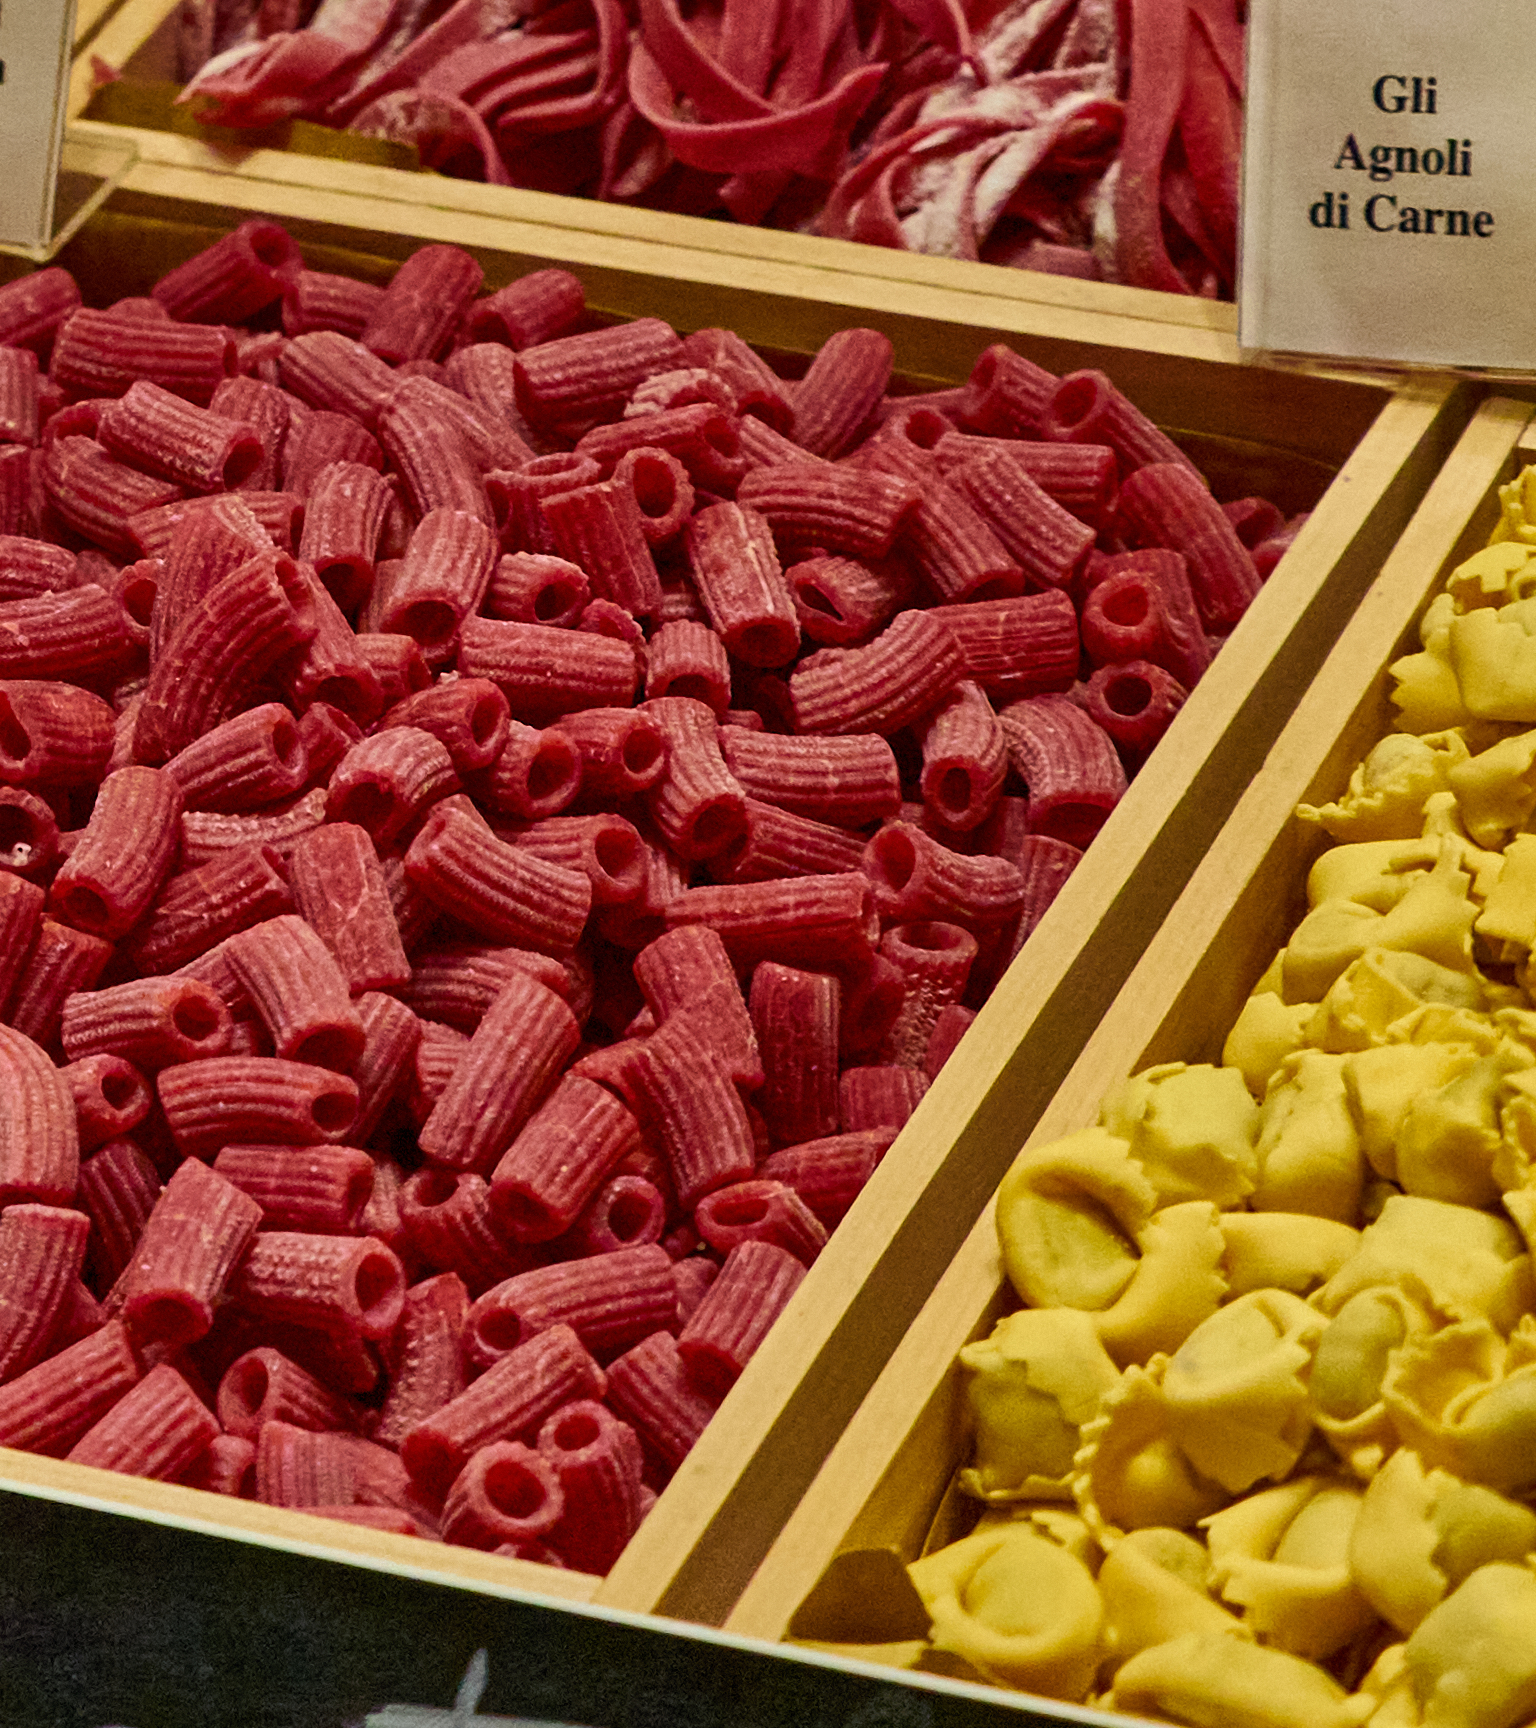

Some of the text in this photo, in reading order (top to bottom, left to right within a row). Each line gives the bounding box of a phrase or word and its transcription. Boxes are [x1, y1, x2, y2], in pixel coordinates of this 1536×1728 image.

[1372, 74, 1439, 115] Gli
[1334, 133, 1473, 181] Agnoli
[1309, 191, 1495, 238] di Carne
